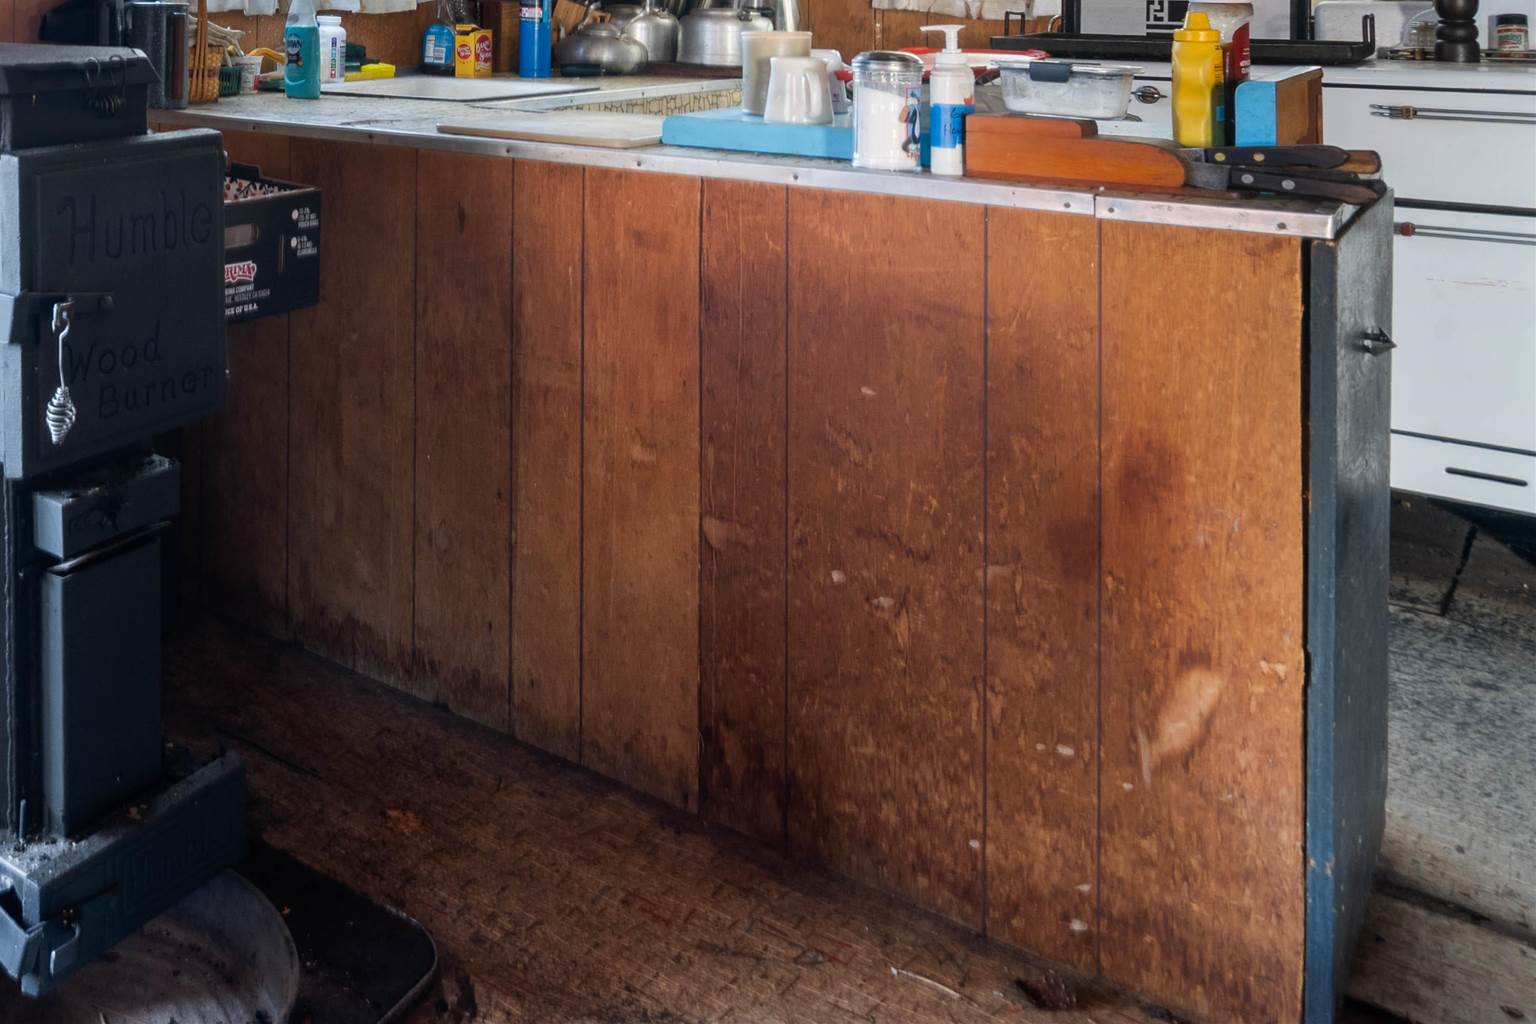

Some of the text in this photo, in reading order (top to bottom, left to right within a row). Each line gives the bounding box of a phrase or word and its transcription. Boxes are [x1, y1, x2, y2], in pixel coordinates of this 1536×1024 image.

[56, 189, 211, 265] Humble
[65, 319, 161, 384] Wood
[99, 365, 213, 419] Burner
